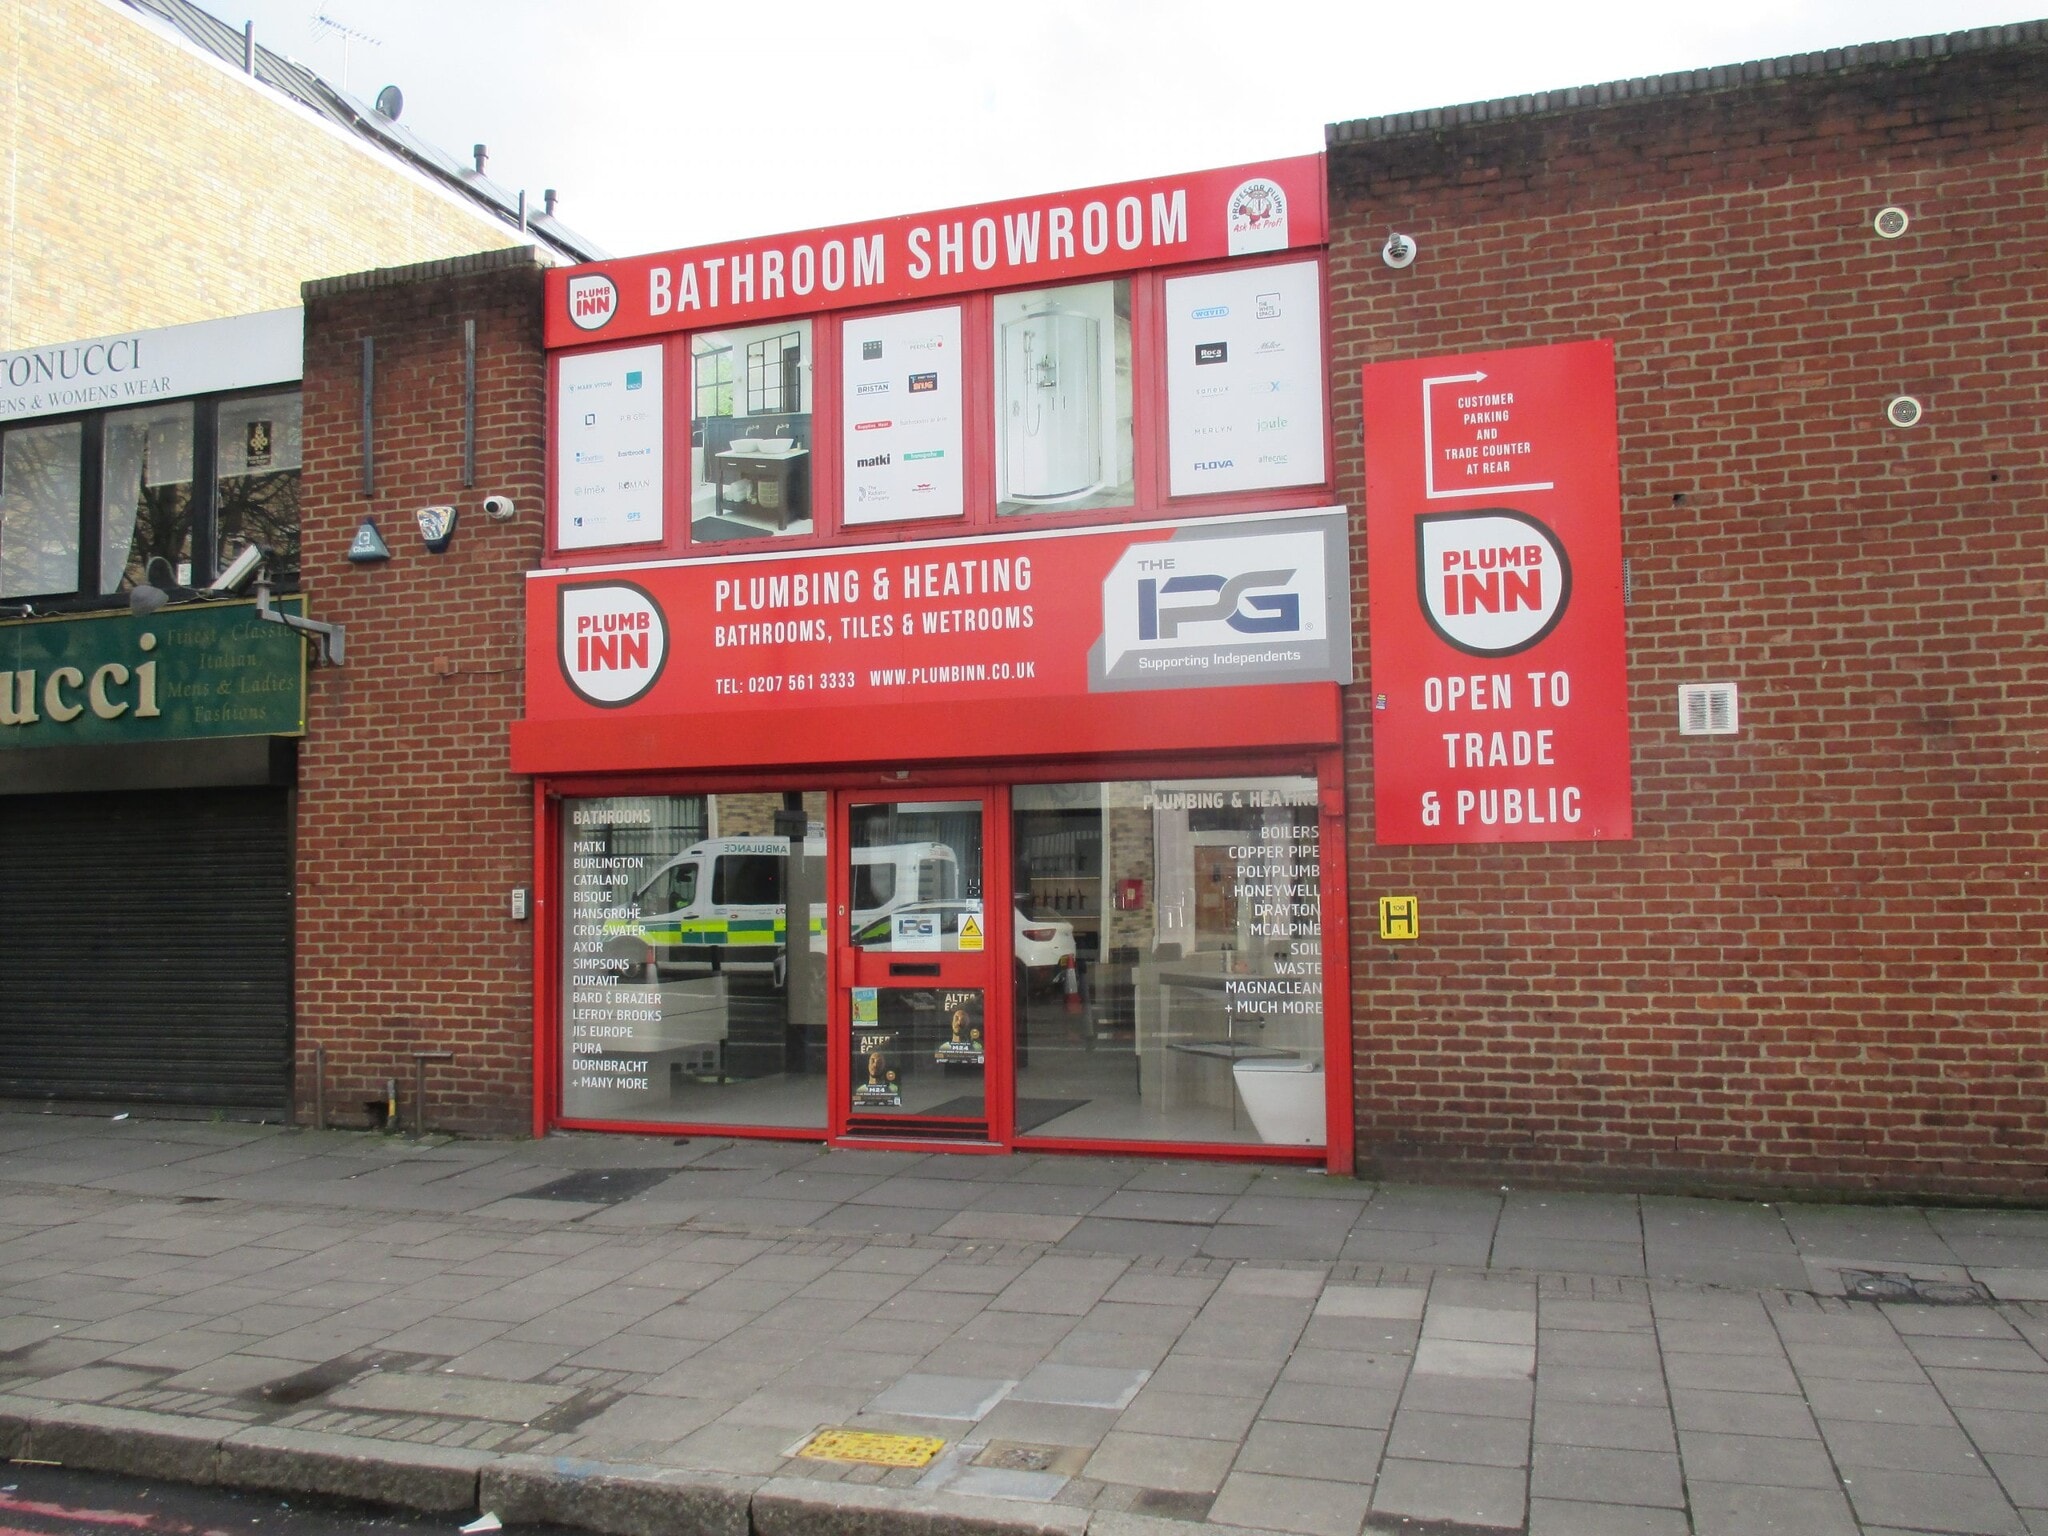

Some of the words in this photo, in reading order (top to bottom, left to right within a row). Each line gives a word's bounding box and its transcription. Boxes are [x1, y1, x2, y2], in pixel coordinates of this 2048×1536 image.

[1232, 184, 1265, 220] PROFESSOR
[1267, 187, 1283, 214] PLUMB
[1233, 223, 1248, 233] Ask
[650, 234, 884, 316] BATHROOM
[907, 189, 1188, 280] SHOWROOM
[576, 286, 610, 299] PLUMB
[576, 297, 610, 316] INN
[1195, 309, 1226, 318] wavin
[1201, 349, 1222, 357] Roca
[31, 394, 42, 410] &
[49, 384, 118, 408] WOMENS
[124, 376, 171, 397] WEAR
[857, 384, 889, 393] BRISTAN
[1458, 393, 1514, 408] CUSTOMER
[1464, 410, 1509, 425] PARKING
[1194, 425, 1233, 434] MERLYN
[1257, 417, 1288, 432] joule
[1476, 428, 1497, 440] AND
[1445, 446, 1478, 460] TRADE
[1482, 442, 1531, 457] COUNTER
[857, 453, 890, 468] matki
[1194, 460, 1234, 470] FLOVA
[1467, 463, 1478, 475] AT
[1483, 461, 1511, 474] REAR
[618, 480, 650, 490] ROMAN
[353, 545, 376, 553] Chubb
[1443, 545, 1542, 571] PLUMB
[1137, 559, 1176, 571] THE
[715, 569, 859, 612] PLUMBING
[873, 567, 889, 601] &
[904, 556, 1032, 599] HEATING
[1443, 569, 1542, 616] INN
[1138, 568, 1300, 640] IPG
[578, 612, 650, 634] PLUMB
[715, 619, 833, 648] BATHROOMS,
[840, 615, 893, 641] TILES
[902, 613, 914, 636] &
[922, 605, 1034, 635] WETROOMS
[577, 632, 649, 673] INN
[1138, 657, 1209, 679] Supporting
[1213, 650, 1301, 674] Independents
[0, 632, 161, 725] ucci
[716, 678, 742, 694] TEL:
[748, 676, 783, 693] 0207
[788, 673, 814, 692] 561
[820, 672, 856, 690] 3333
[869, 661, 1035, 687] WWW.PLUMBINN.CO.UK
[168, 681, 210, 698] Mens
[217, 679, 231, 695] &
[239, 672, 295, 694] Ladies
[1424, 674, 1512, 712] OPEN
[1528, 671, 1570, 707] TO
[195, 702, 266, 722] Fashions
[1443, 730, 1554, 768] TRADE
[1143, 792, 1224, 810] PLUMBING
[1231, 791, 1243, 808] &
[1250, 789, 1319, 808] HEATING
[1421, 791, 1441, 826] &
[1457, 787, 1581, 825] PUBLIC
[573, 809, 651, 825] BATHROOMS
[1261, 825, 1320, 839] BOILERS
[573, 842, 606, 852] MATKI
[1228, 846, 1283, 859] COPPER
[1289, 845, 1320, 858] PIPE
[573, 857, 644, 869] BURLINGTON
[1237, 865, 1320, 878] POLYPLUMB
[573, 875, 629, 886] CATALANO
[573, 891, 613, 903] BISQUE
[1234, 885, 1320, 898] HONEYWELL
[573, 908, 641, 919] HANSGROHE
[1254, 903, 1320, 917] DRAYTON
[573, 925, 646, 936] CROSSWATER
[898, 919, 933, 934] IPG
[1250, 923, 1321, 936] MCALPINE
[572, 941, 604, 953] AXOR
[1290, 943, 1322, 955] SOIL
[573, 958, 630, 970] SIMPSONS
[1274, 962, 1322, 975] WASTE
[573, 975, 619, 987] DURAVIT
[1225, 982, 1322, 995] MAGNACLEAN
[573, 992, 603, 1004] BARD
[616, 993, 662, 1005] BRAZIER
[1224, 1003, 1233, 1013] +
[1237, 1001, 1278, 1014] MUCH
[1282, 1001, 1323, 1014] MORE
[573, 1009, 613, 1021] LEFROY
[617, 1010, 662, 1022] BROOKS
[572, 1026, 587, 1036] JIS
[590, 1027, 634, 1038] EUROPE
[572, 1043, 602, 1054] PURA
[572, 1060, 648, 1072] DORNBRACHT
[581, 1077, 614, 1089] MANY
[616, 1078, 648, 1090] MORE
